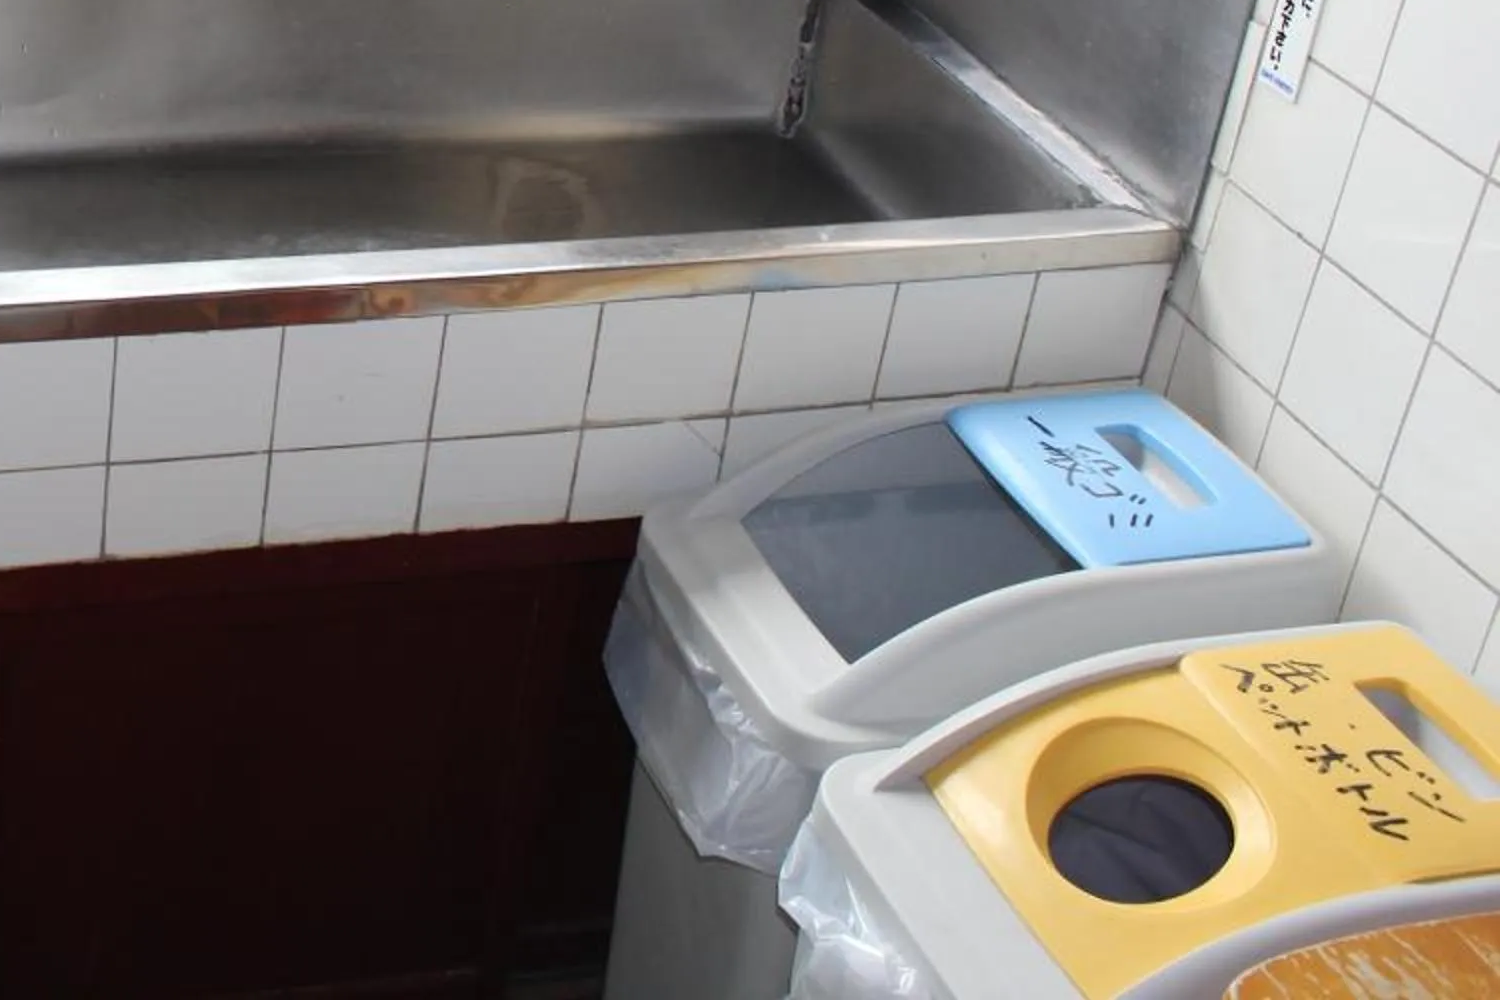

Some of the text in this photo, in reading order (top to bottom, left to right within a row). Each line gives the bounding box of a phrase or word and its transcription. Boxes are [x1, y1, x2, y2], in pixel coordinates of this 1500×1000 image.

[1026, 415, 1154, 528] 一般ゴミ
[1218, 663, 1411, 841] ペットボトル
